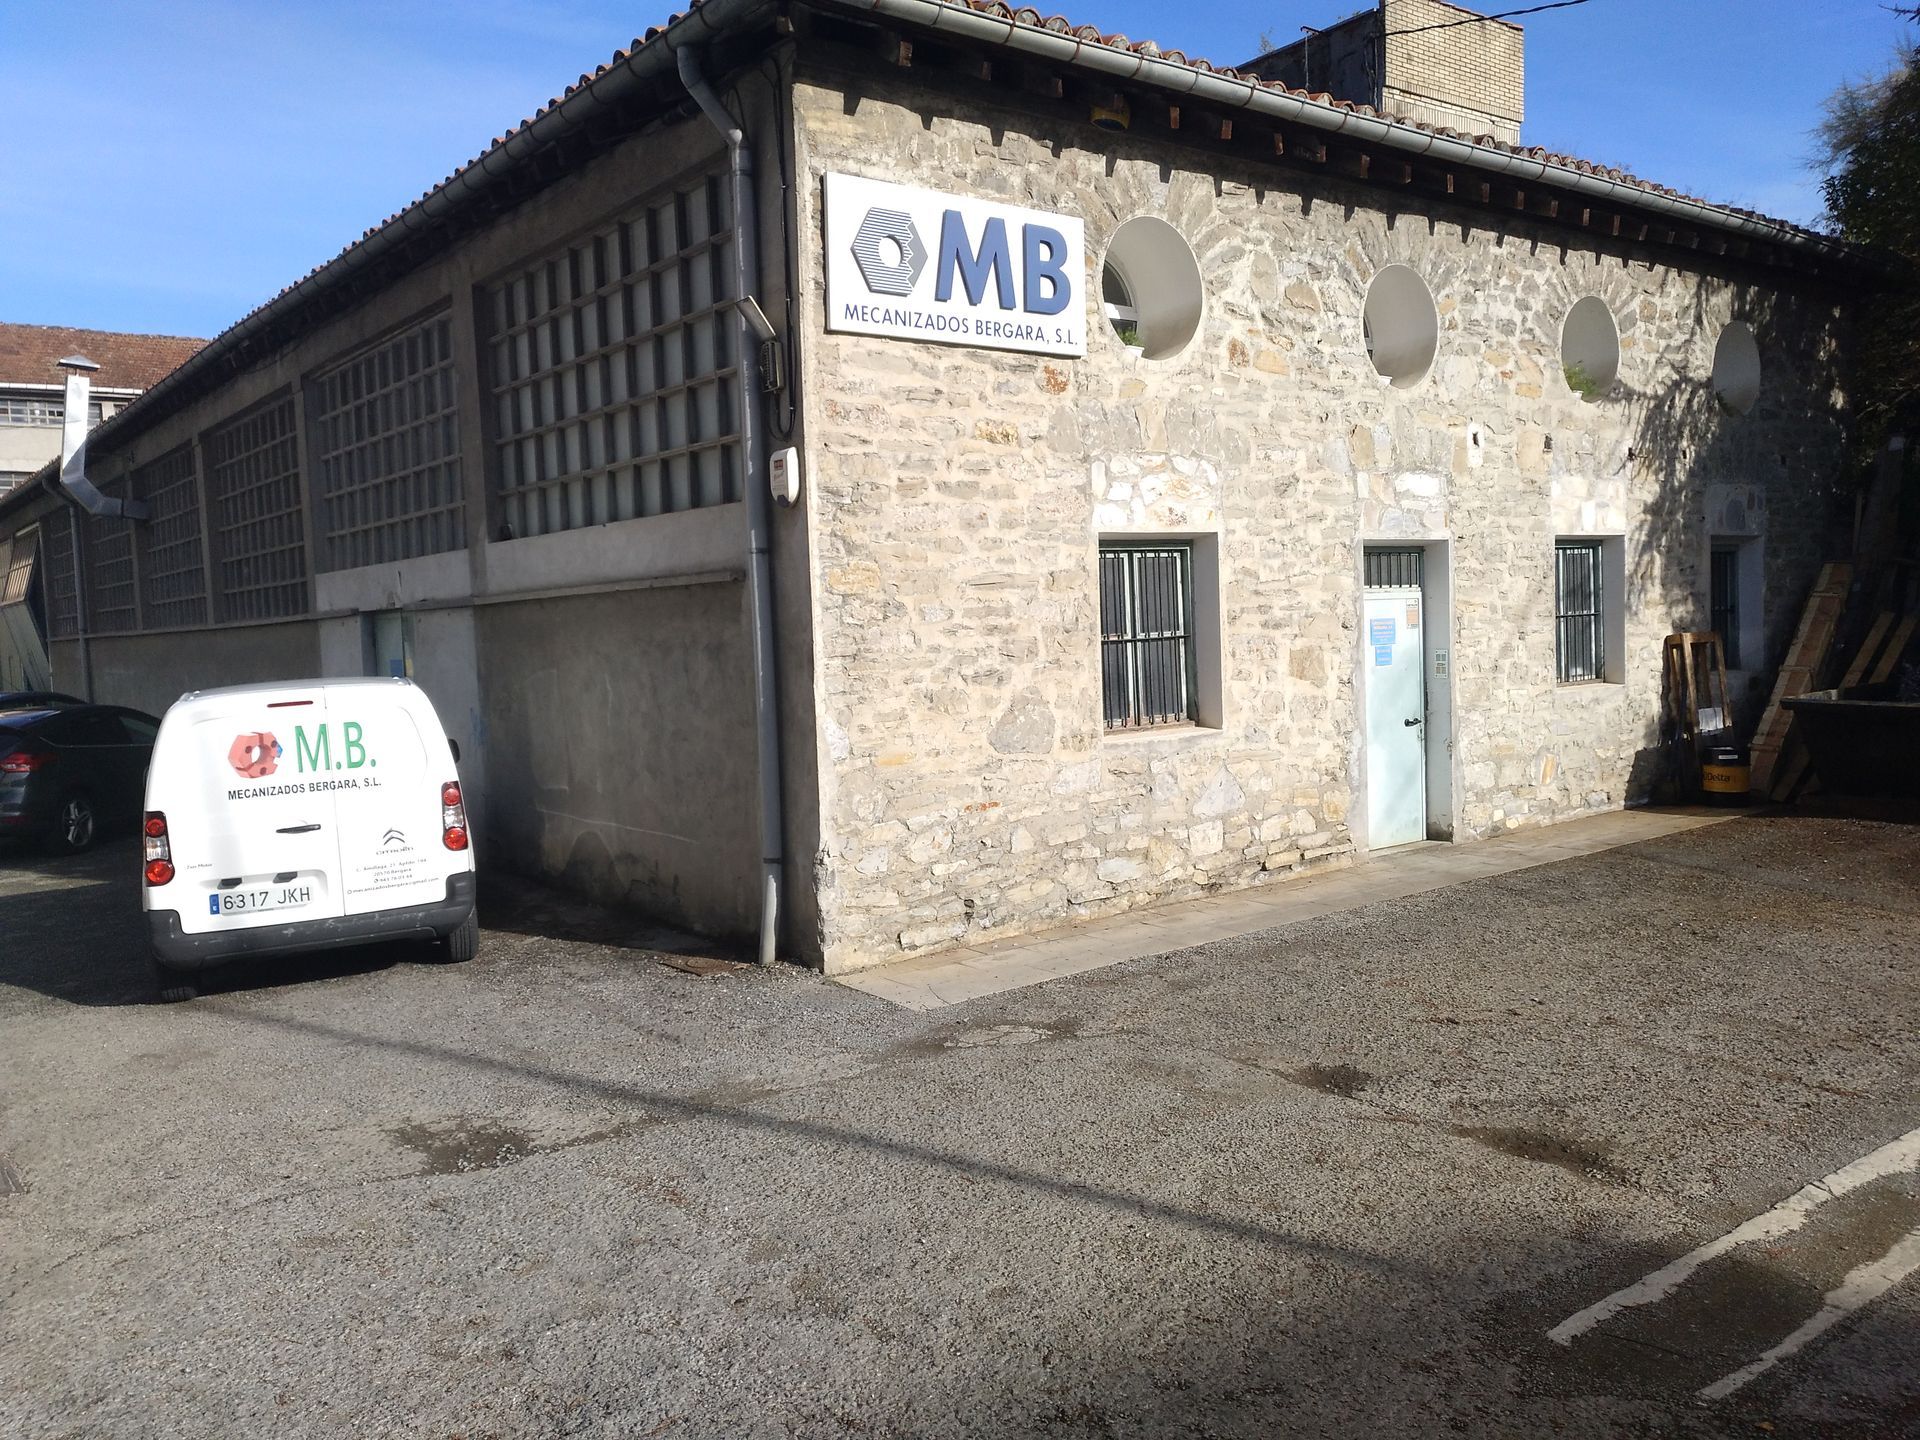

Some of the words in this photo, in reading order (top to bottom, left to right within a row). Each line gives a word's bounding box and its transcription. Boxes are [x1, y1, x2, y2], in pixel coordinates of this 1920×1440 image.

[935, 209, 1071, 316] MB
[844, 303, 969, 334] MECANIZADOS
[975, 319, 1050, 345] BERGARA,
[1055, 328, 1078, 346] S.L.
[294, 721, 377, 773] M.B.
[227, 783, 306, 801] MECANIZADOS
[308, 778, 361, 793] BERGARA,
[363, 777, 382, 788] S.L.
[223, 891, 269, 910] 6317
[277, 886, 311, 904] JKH
